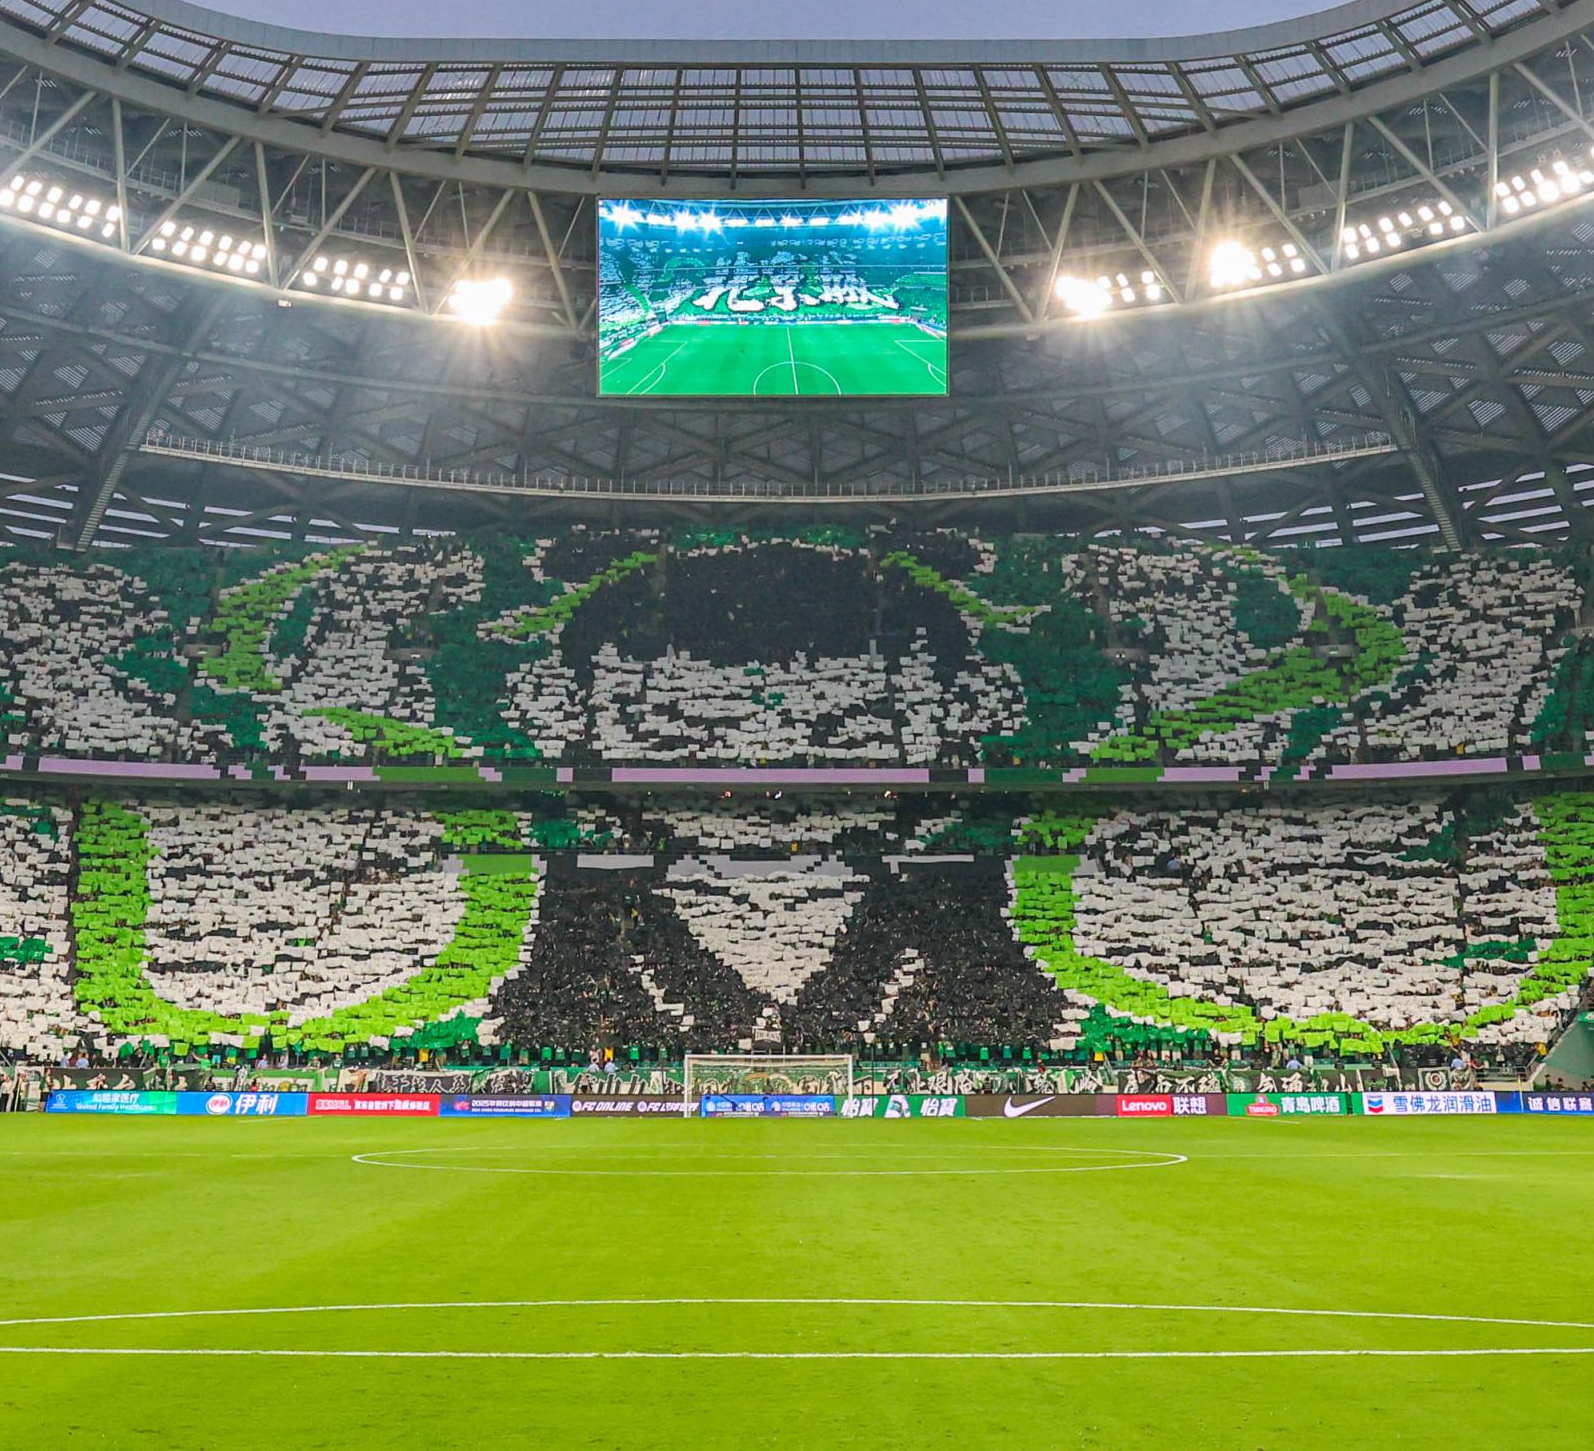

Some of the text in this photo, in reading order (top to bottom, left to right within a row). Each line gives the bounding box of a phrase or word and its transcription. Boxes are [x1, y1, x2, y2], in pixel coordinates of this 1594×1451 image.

[235, 1094, 279, 1114] 伊利
[920, 1098, 958, 1117] 怡寶
[1121, 1100, 1167, 1112] Lenovo
[1172, 1096, 1207, 1114] 联想
[1281, 1096, 1340, 1113] 青岛啤酒
[1393, 1095, 1492, 1112] 雪佛龙润滑油
[1527, 1096, 1593, 1112] 诚信联赛
